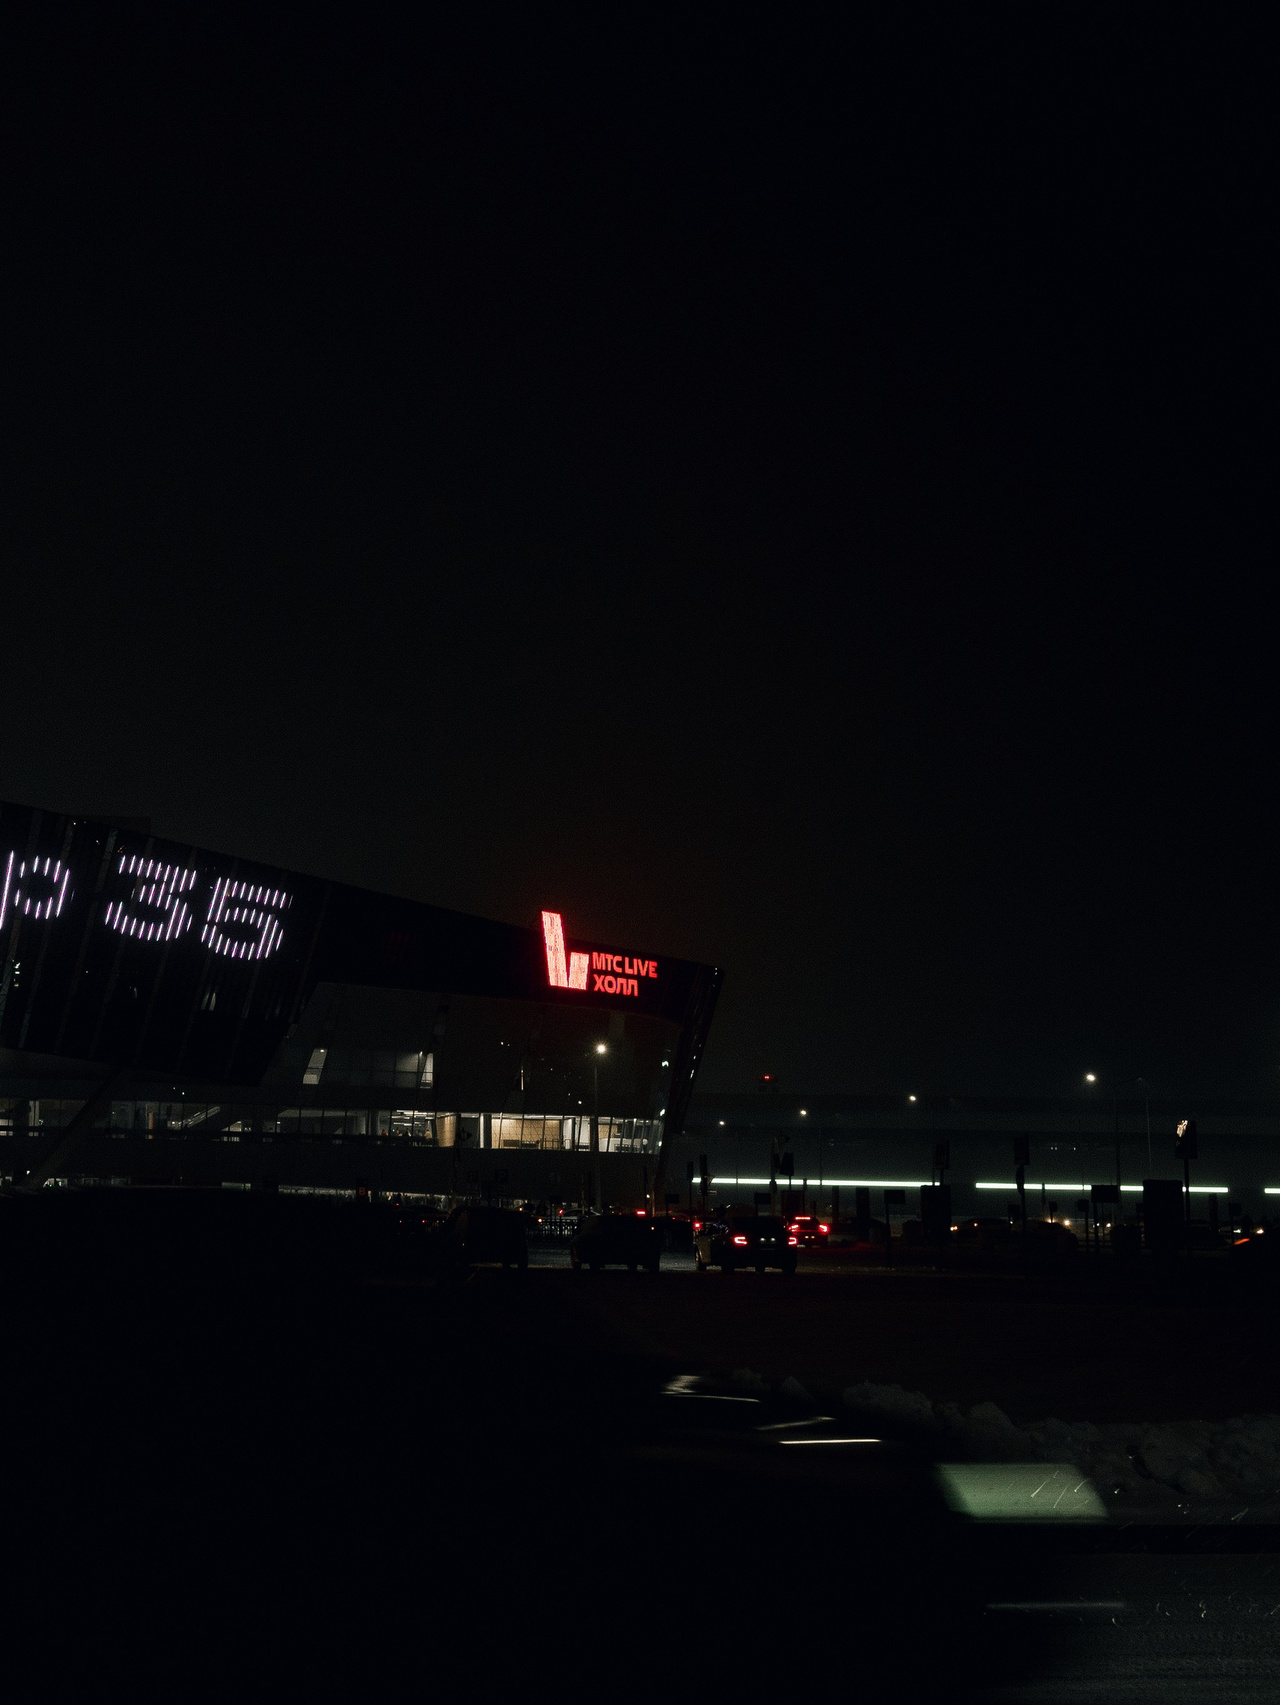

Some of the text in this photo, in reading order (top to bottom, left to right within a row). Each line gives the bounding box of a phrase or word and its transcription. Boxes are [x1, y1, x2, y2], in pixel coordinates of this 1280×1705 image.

[104, 854, 293, 961] 35
[624, 957, 658, 978] LIVE
[593, 974, 638, 996] ХОЛЛ
